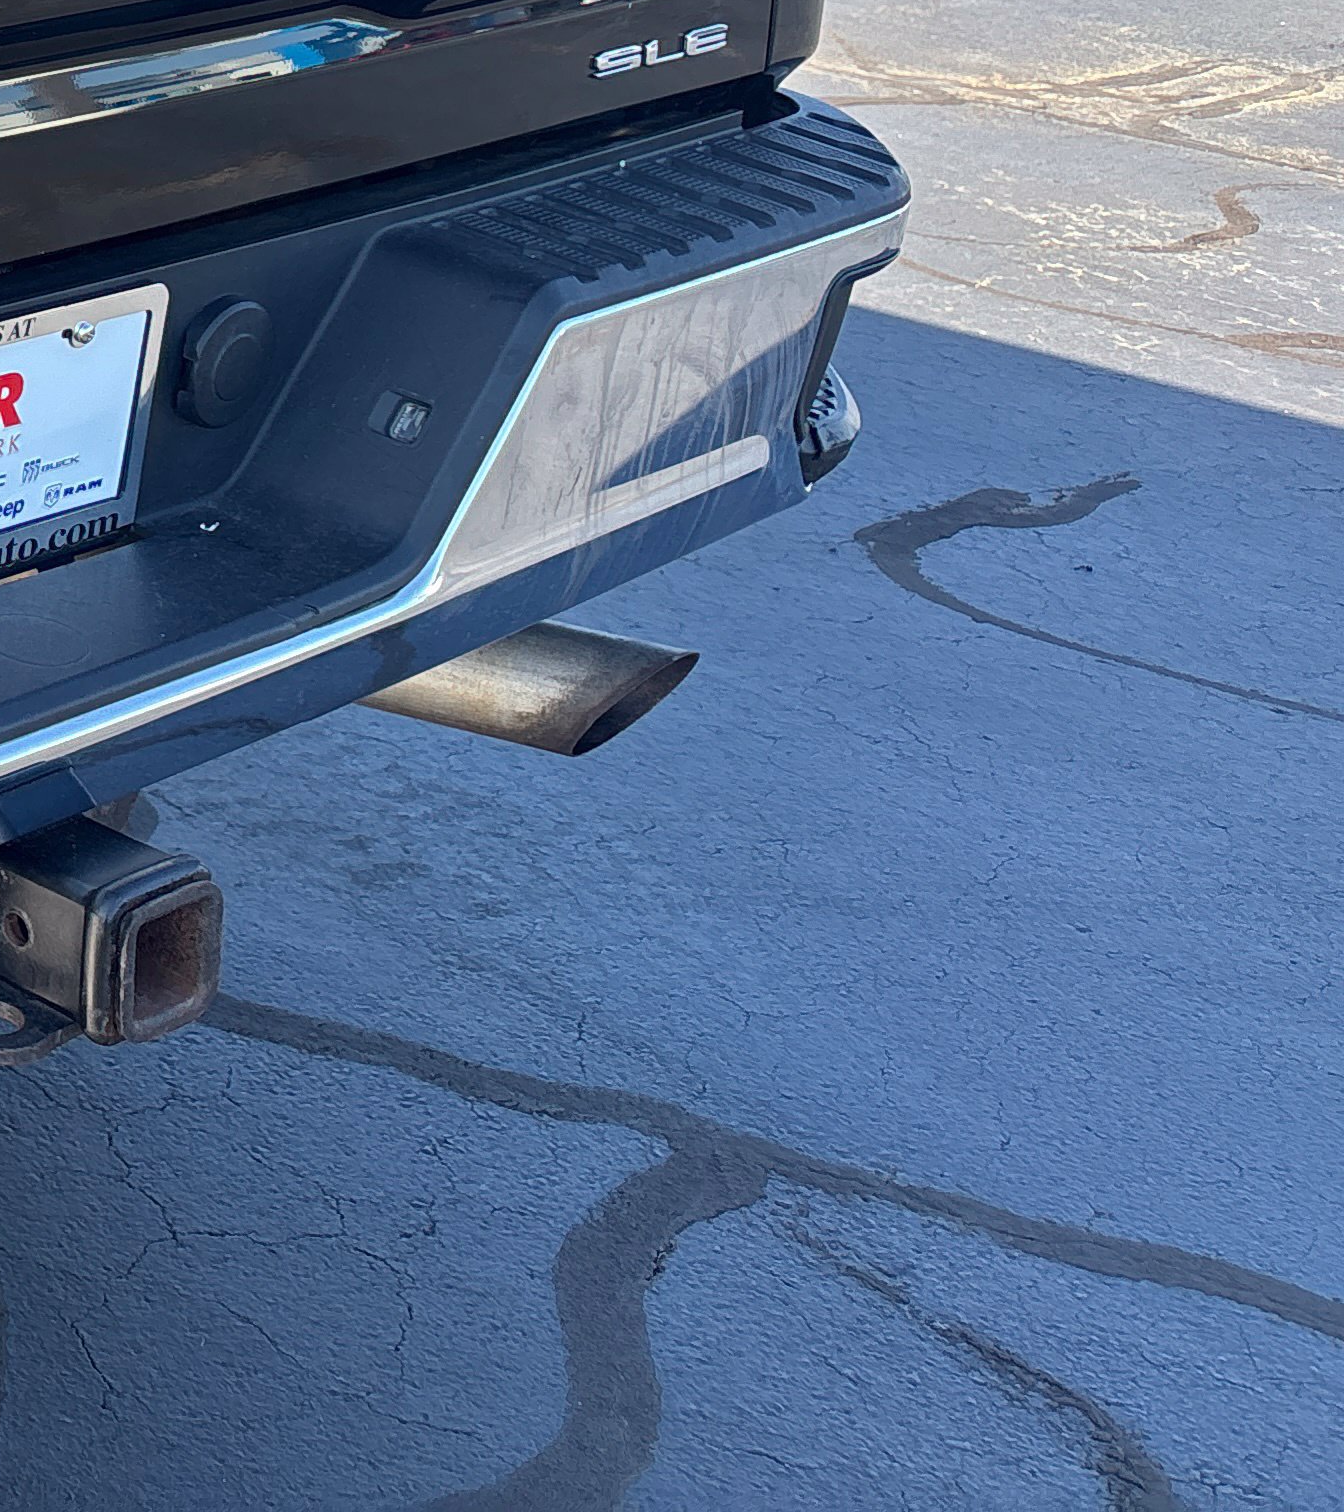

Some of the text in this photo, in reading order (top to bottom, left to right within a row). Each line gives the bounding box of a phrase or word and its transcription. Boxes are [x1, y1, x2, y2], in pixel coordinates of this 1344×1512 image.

[590, 23, 729, 78] SLE
[7, 317, 37, 339] AT
[63, 478, 103, 497] RAM
